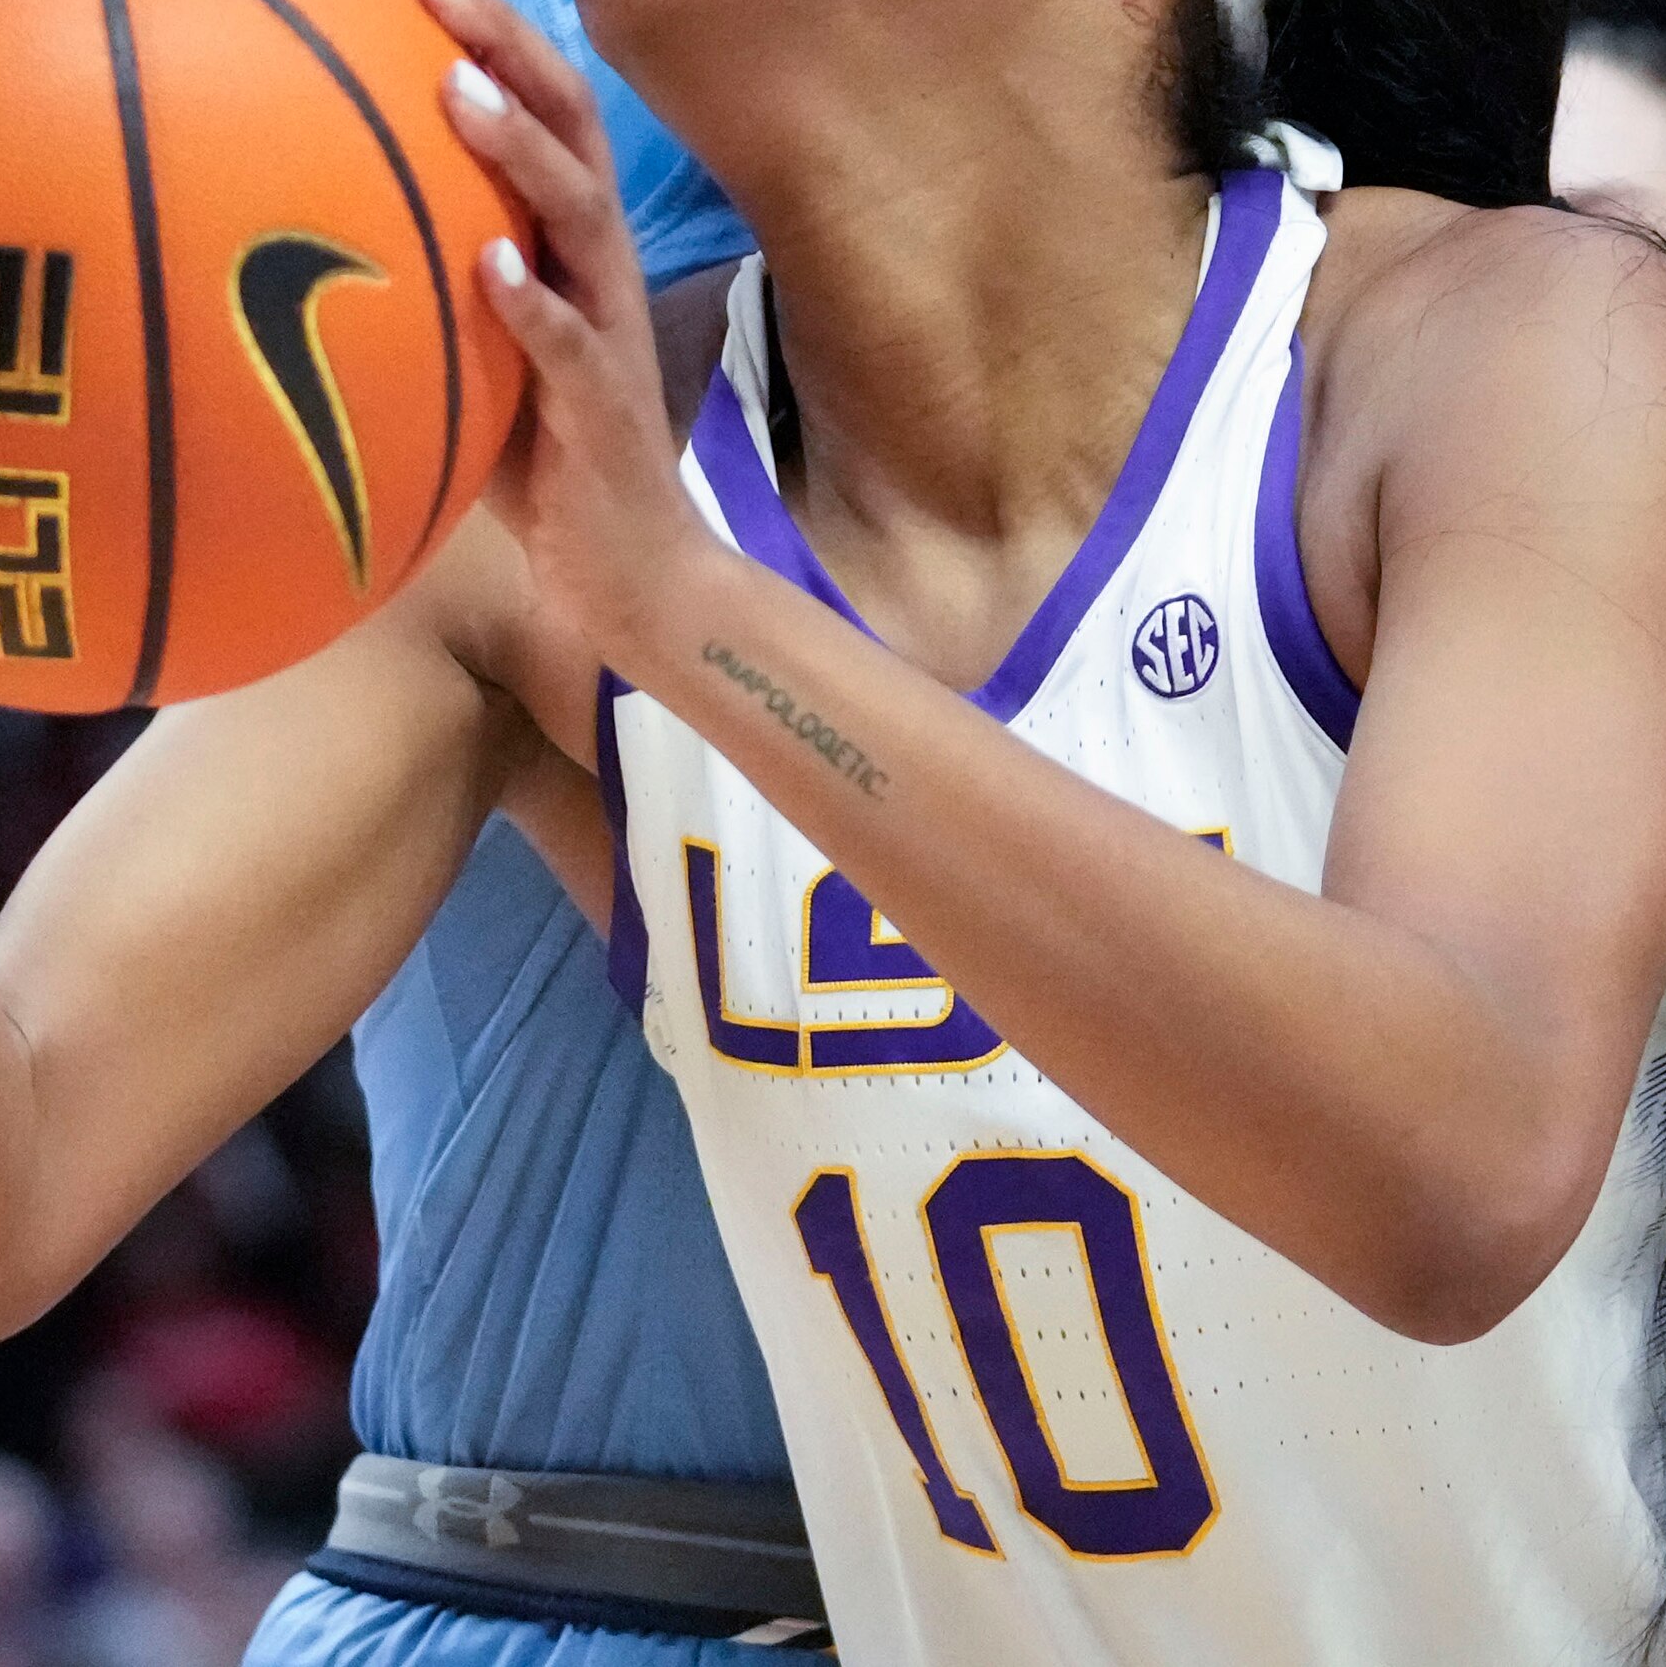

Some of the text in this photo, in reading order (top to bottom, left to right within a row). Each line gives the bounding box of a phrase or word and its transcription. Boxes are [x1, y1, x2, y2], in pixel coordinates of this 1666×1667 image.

[1135, 597, 1216, 694] SEC
[682, 826, 1235, 1078] LS
[789, 1148, 1222, 1563] 10
